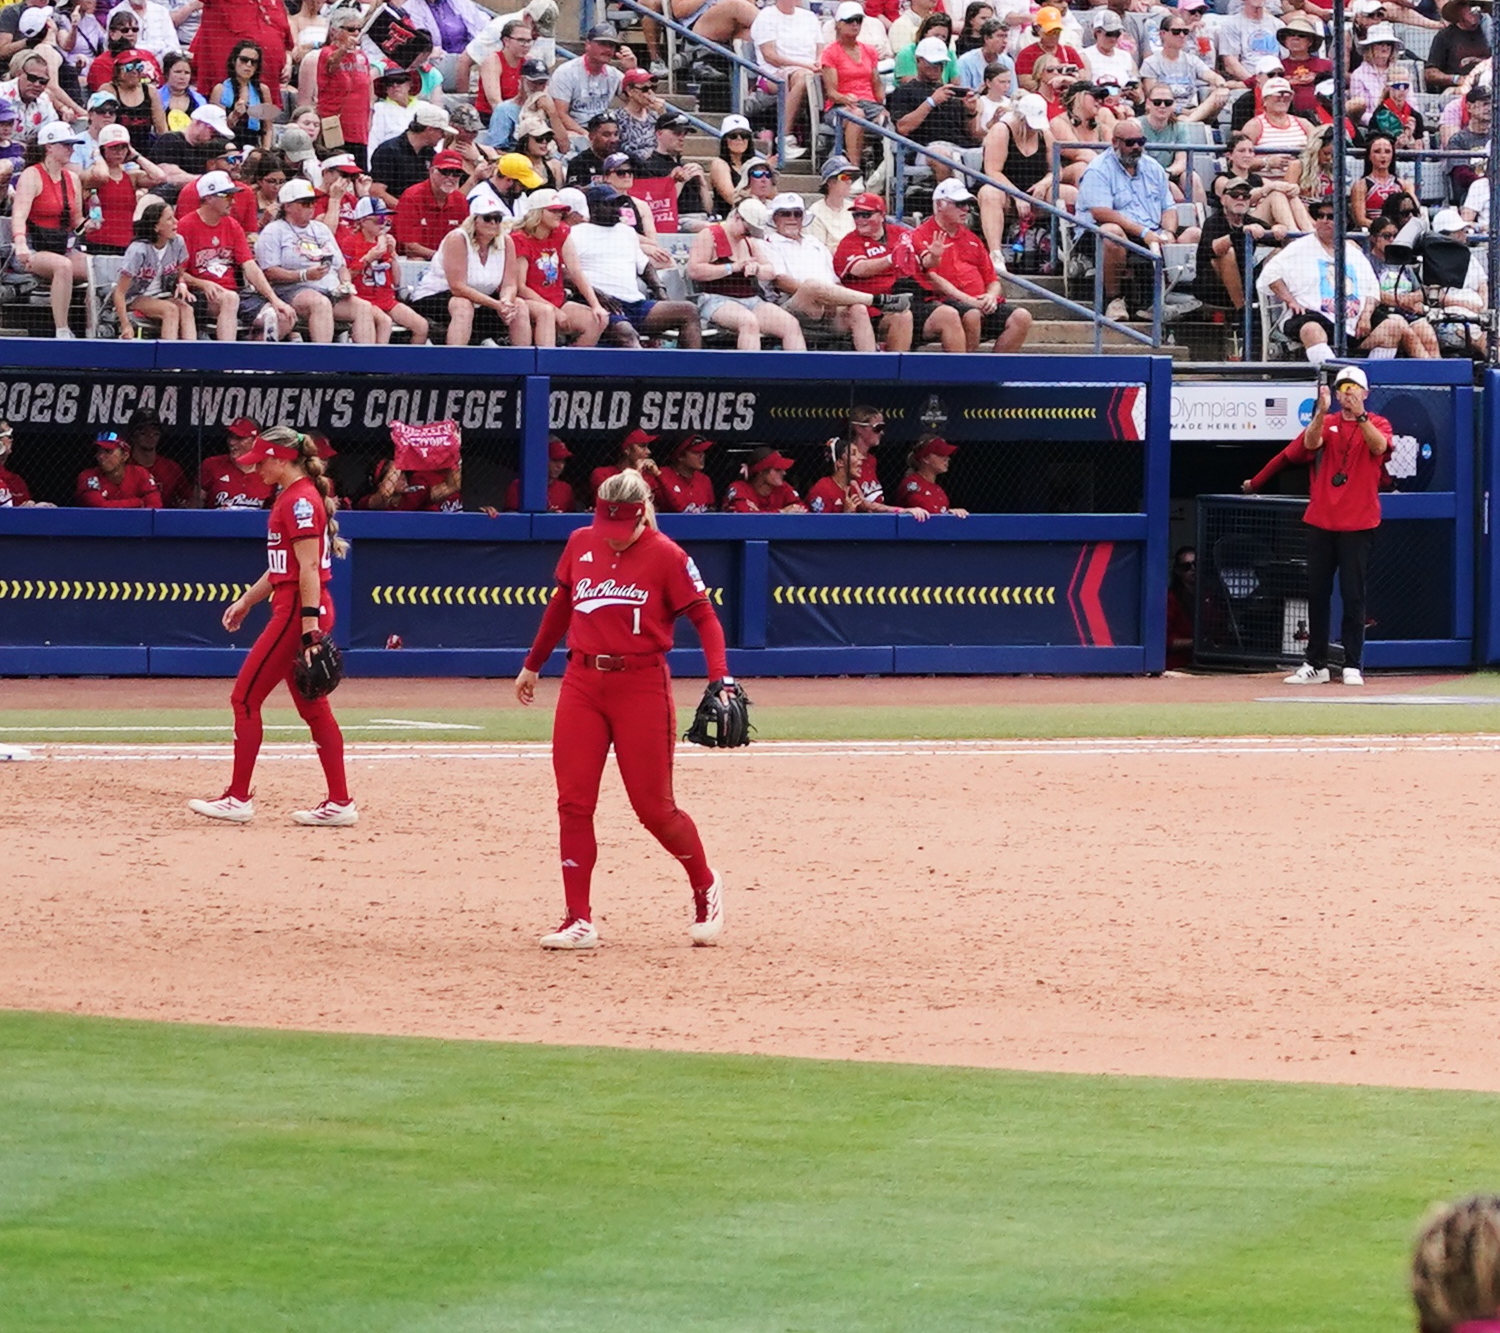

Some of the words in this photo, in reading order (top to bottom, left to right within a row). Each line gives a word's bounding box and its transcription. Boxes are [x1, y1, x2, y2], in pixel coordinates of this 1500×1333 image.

[0, 382, 80, 424] 026
[87, 384, 178, 426] NCAA
[190, 386, 354, 428] WOMEN'S
[363, 388, 507, 430] COLLEGE
[516, 389, 632, 431] ORLD
[639, 390, 757, 431] SERIES
[1170, 396, 1258, 418] Olympians
[632, 608, 641, 635] 1
